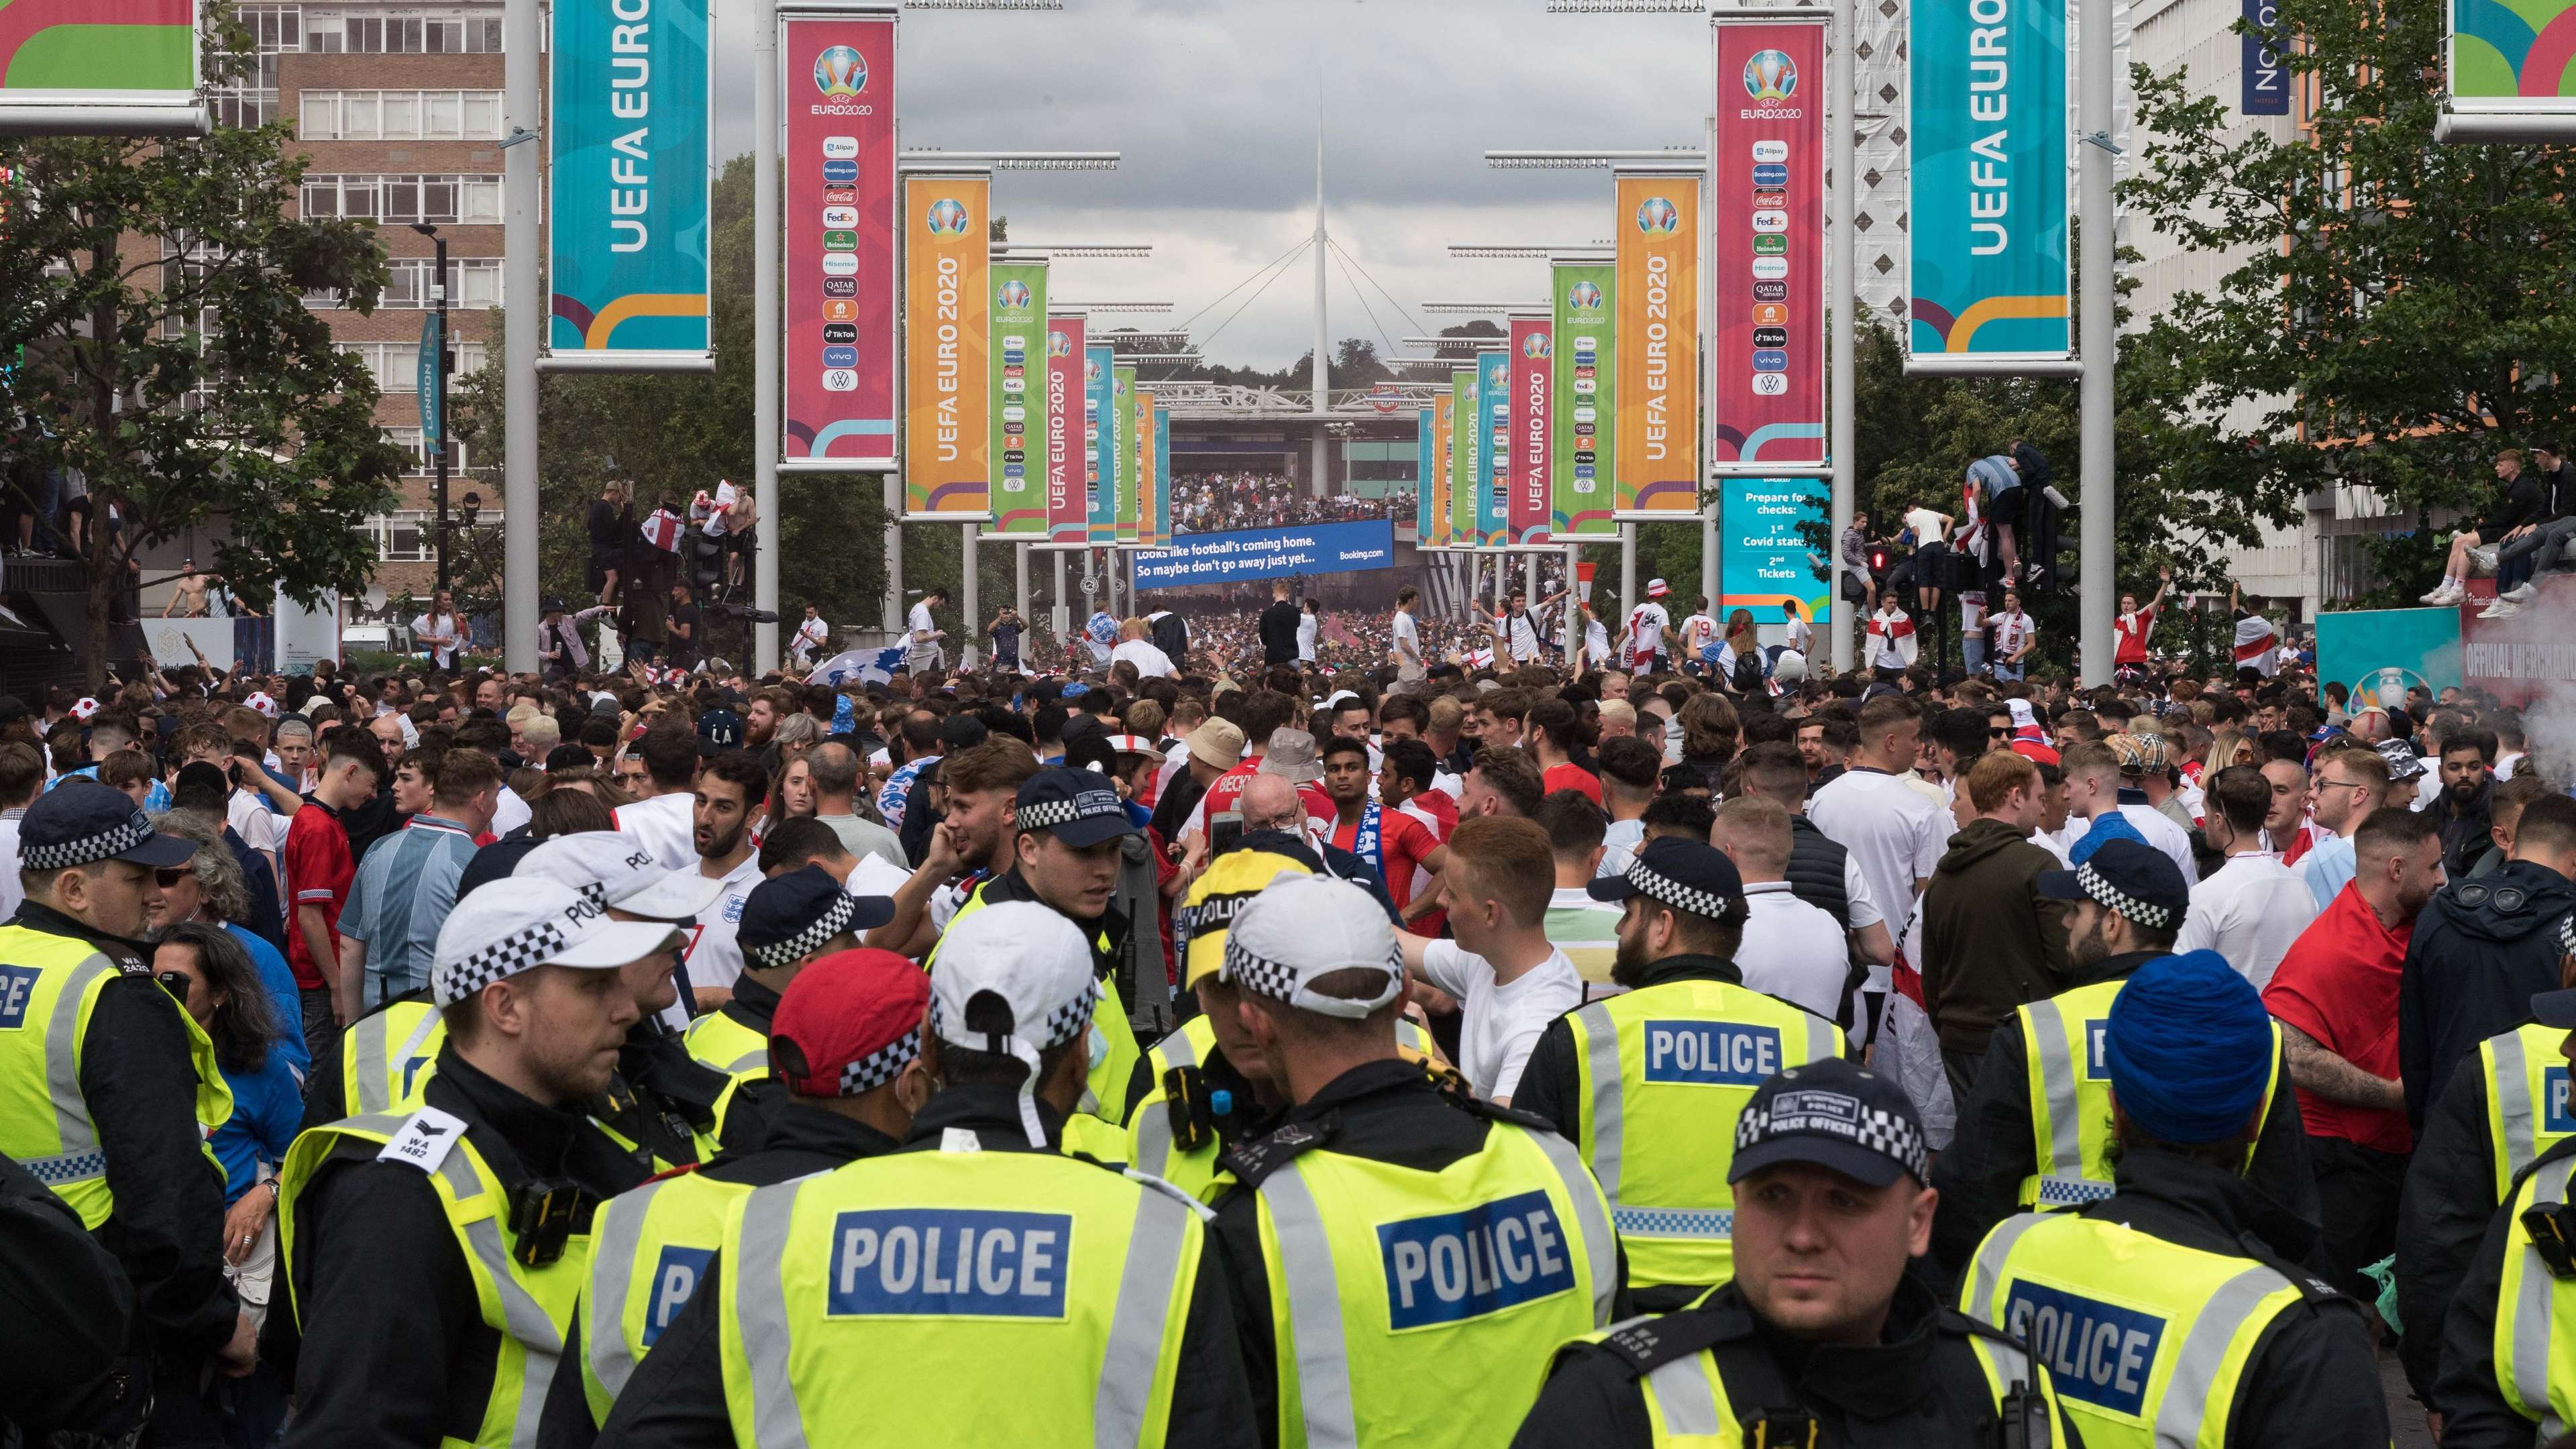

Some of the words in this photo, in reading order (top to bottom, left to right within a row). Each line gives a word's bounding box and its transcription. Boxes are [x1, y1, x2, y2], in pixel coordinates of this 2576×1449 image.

[612, 0, 649, 118] EURO
[1970, 0, 2007, 121] EURO
[812, 105, 872, 115] EURO2020
[830, 95, 851, 103] UEFA
[1760, 99, 1781, 107] UEFA
[1741, 109, 1801, 119] EURO2020
[1765, 147, 1784, 155] Alipay
[611, 127, 648, 252] UEFA
[1971, 129, 2008, 255] UEFA
[827, 213, 853, 221] FedEx
[1756, 217, 1783, 225] FedEx
[826, 281, 854, 289] QATAR
[938, 258, 958, 321] 2020
[1648, 256, 1667, 319] 2020
[1756, 285, 1784, 293] QATAR
[938, 325, 958, 392] EURO
[1648, 323, 1667, 390] EURO
[424, 364, 433, 430] LONDON
[1051, 370, 1065, 413] 2020
[1530, 372, 1544, 415] 2020
[938, 396, 958, 462] UEFA
[1051, 417, 1065, 463] EURO
[1468, 413, 1477, 443] 2020
[1647, 394, 1667, 460] UEFA
[1529, 421, 1544, 464] EURO
[1052, 465, 1066, 510] UEFA
[1529, 468, 1543, 511] UEFA
[1746, 493, 1788, 506] Prepare
[1792, 493, 1806, 502] fo
[1757, 505, 1796, 515] checks:
[1171, 545, 1189, 557] like
[1242, 538, 1281, 551] coming
[1283, 537, 1316, 548] home.
[1340, 549, 1383, 560] Booking.com
[1743, 537, 1773, 546] Covid
[1776, 537, 1807, 546] statu
[1137, 565, 1150, 576] So
[1153, 561, 1189, 578] maybe
[1222, 561, 1236, 573] go
[1238, 557, 1266, 570] away
[1267, 554, 1287, 569] just
[1289, 552, 1316, 567] yet...
[1757, 569, 1796, 578] Tickets
[1769, 556, 1784, 566] 2nd
[2467, 643, 2511, 678] OFFICIAL
[712, 729, 732, 743] LA
[1219, 775, 1252, 793] BECK
[1081, 806, 1102, 816] POLICE
[625, 852, 653, 871] POL
[565, 899, 602, 928] POL
[1200, 897, 1246, 925] POLIC
[1652, 1031, 1774, 1075] POLICE
[1807, 1102, 1843, 1114] POLICE
[1770, 1117, 1805, 1133] POLICE
[1809, 1117, 1856, 1136] OFFICER
[400, 1146, 426, 1159] 1482
[409, 1138, 429, 1149] WA
[840, 1226, 1056, 1296] POLICE
[1394, 1210, 1563, 1308] POLICE
[2011, 1297, 2150, 1395] POLICE
